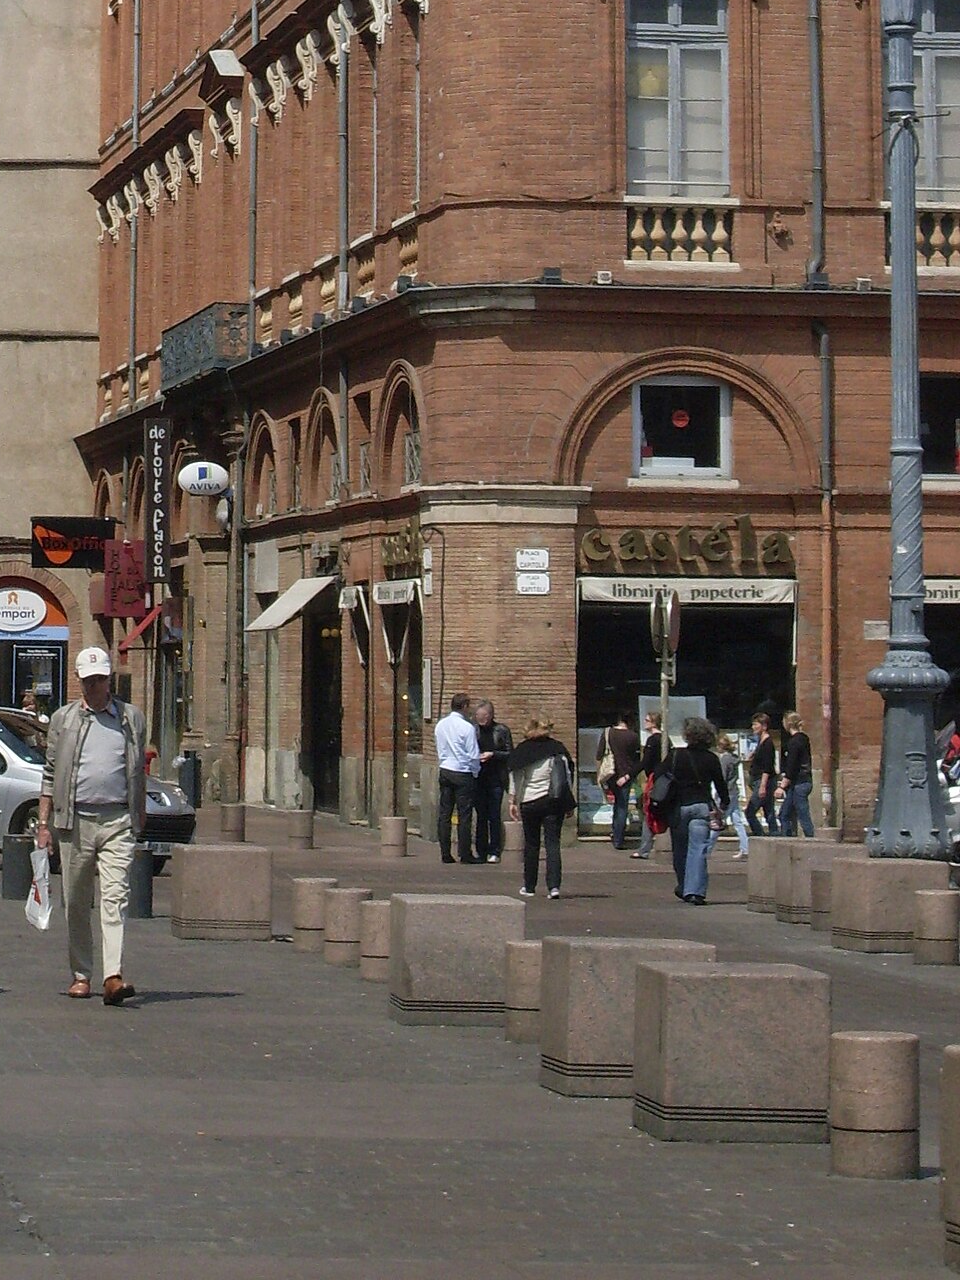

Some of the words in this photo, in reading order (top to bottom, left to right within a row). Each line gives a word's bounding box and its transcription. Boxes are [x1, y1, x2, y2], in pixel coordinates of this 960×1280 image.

[149, 425, 165, 439] de
[189, 482, 221, 490] AVIVA
[581, 513, 797, 562] castéla
[691, 584, 764, 601] papeterie
[89, 654, 97, 663] B
